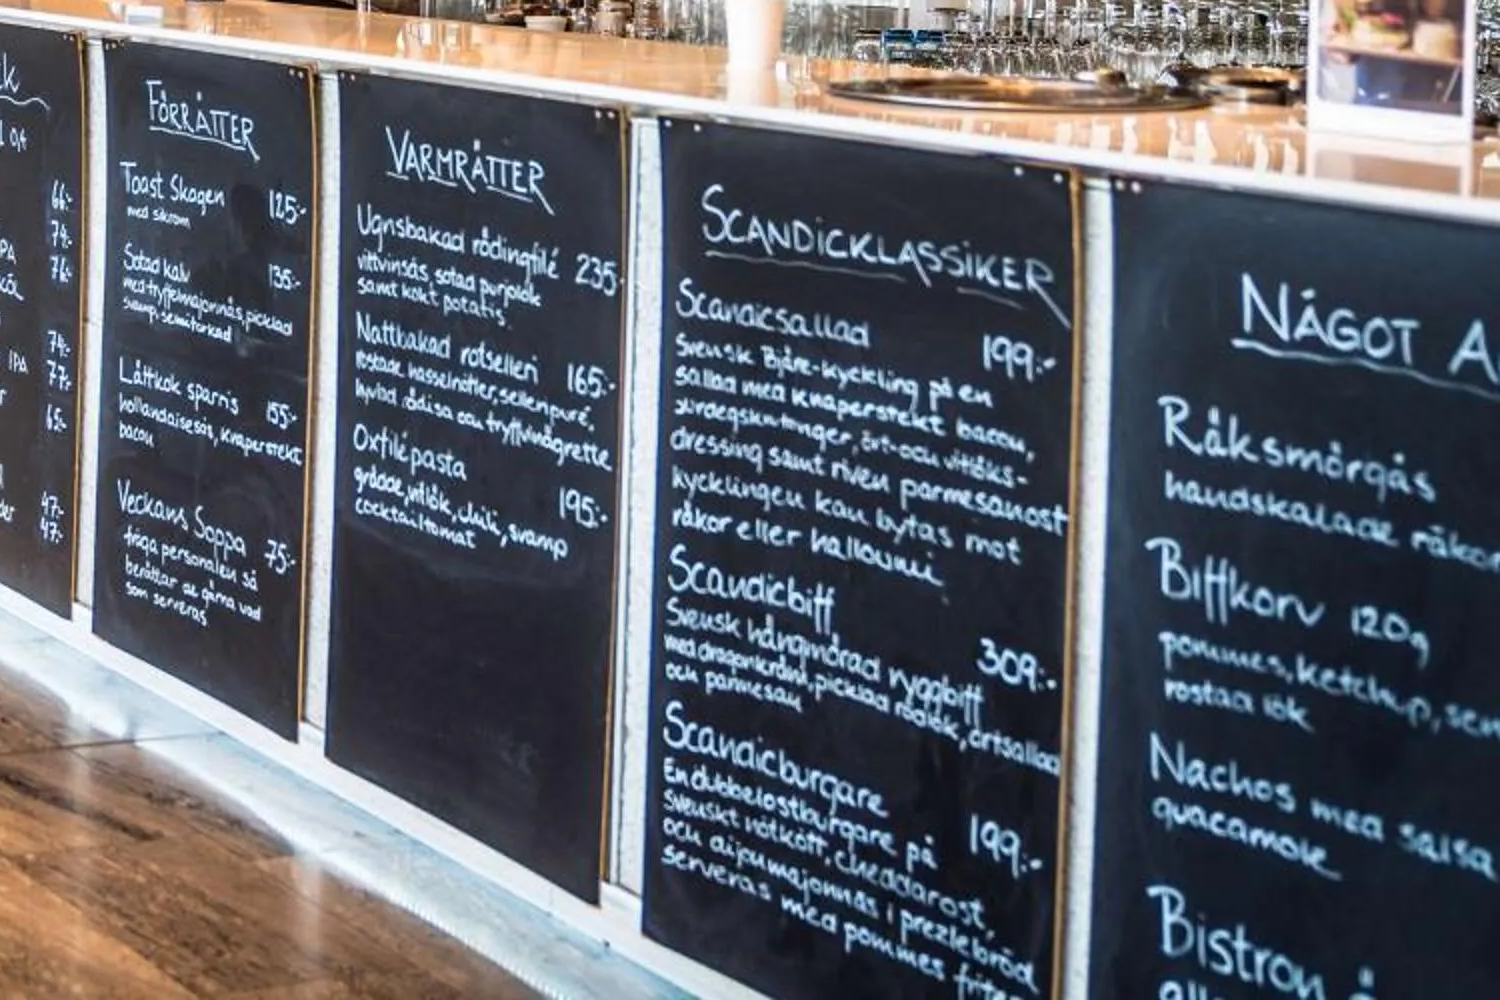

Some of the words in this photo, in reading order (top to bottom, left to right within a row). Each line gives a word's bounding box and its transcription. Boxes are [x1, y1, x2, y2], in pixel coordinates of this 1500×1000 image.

[119, 161, 165, 200] Toast
[170, 173, 225, 217] Skagen
[127, 205, 149, 219] med
[357, 203, 466, 254] Ugnsbakad
[123, 277, 145, 295] med
[357, 277, 398, 298] samt
[401, 280, 439, 307] kokt
[676, 277, 870, 349] Scandicsallad
[8, 349, 29, 375] IPA
[356, 312, 451, 359] Nattbakad
[460, 341, 539, 385] rotselleri
[1241, 271, 1421, 367] NÅGOT
[1448, 318, 1500, 386] A
[674, 364, 737, 396] sallad
[742, 378, 786, 404] med
[791, 385, 948, 437] knaperstekt
[675, 336, 755, 366] Svensk
[928, 377, 954, 412] på
[958, 383, 994, 408] en
[118, 419, 155, 449] bacon
[1157, 394, 1437, 505] Räksmörgås
[669, 425, 764, 475] dressing
[768, 445, 826, 477] samt
[831, 457, 891, 494] riven
[900, 477, 1069, 537] parmesanost
[1164, 470, 1401, 549] handskalade
[117, 477, 189, 531] Veckans
[193, 504, 247, 562] Soppa
[508, 522, 569, 561] svamp
[671, 500, 735, 535] räkor
[736, 515, 802, 551] eller
[814, 489, 871, 529] kan
[875, 503, 955, 552] bytas
[965, 531, 1024, 568] mot
[125, 553, 179, 589] berättar
[238, 601, 262, 622] vad
[161, 542, 237, 583] personalen
[667, 543, 836, 637] Scandicbiff
[1144, 536, 1326, 627] Biffkorv
[125, 581, 149, 599] som
[153, 593, 208, 627] serveras
[663, 633, 697, 661] med
[815, 672, 891, 714] picklad
[665, 596, 744, 640] Svensk
[888, 667, 984, 730] ryggbiff
[665, 662, 699, 684] och
[705, 670, 803, 714] parmesan
[1164, 678, 1254, 714] rostad
[1262, 695, 1315, 733] lök
[662, 700, 890, 819] Scandicburgare
[663, 757, 689, 788] En
[906, 835, 938, 872] på
[663, 817, 703, 847] och
[1150, 731, 1296, 813] Nachos
[1310, 799, 1385, 842] med
[1399, 823, 1499, 882] salsa
[1152, 797, 1343, 881] guacamole
[661, 843, 772, 901] serveras
[781, 894, 838, 934] med
[843, 921, 946, 982] pommes
